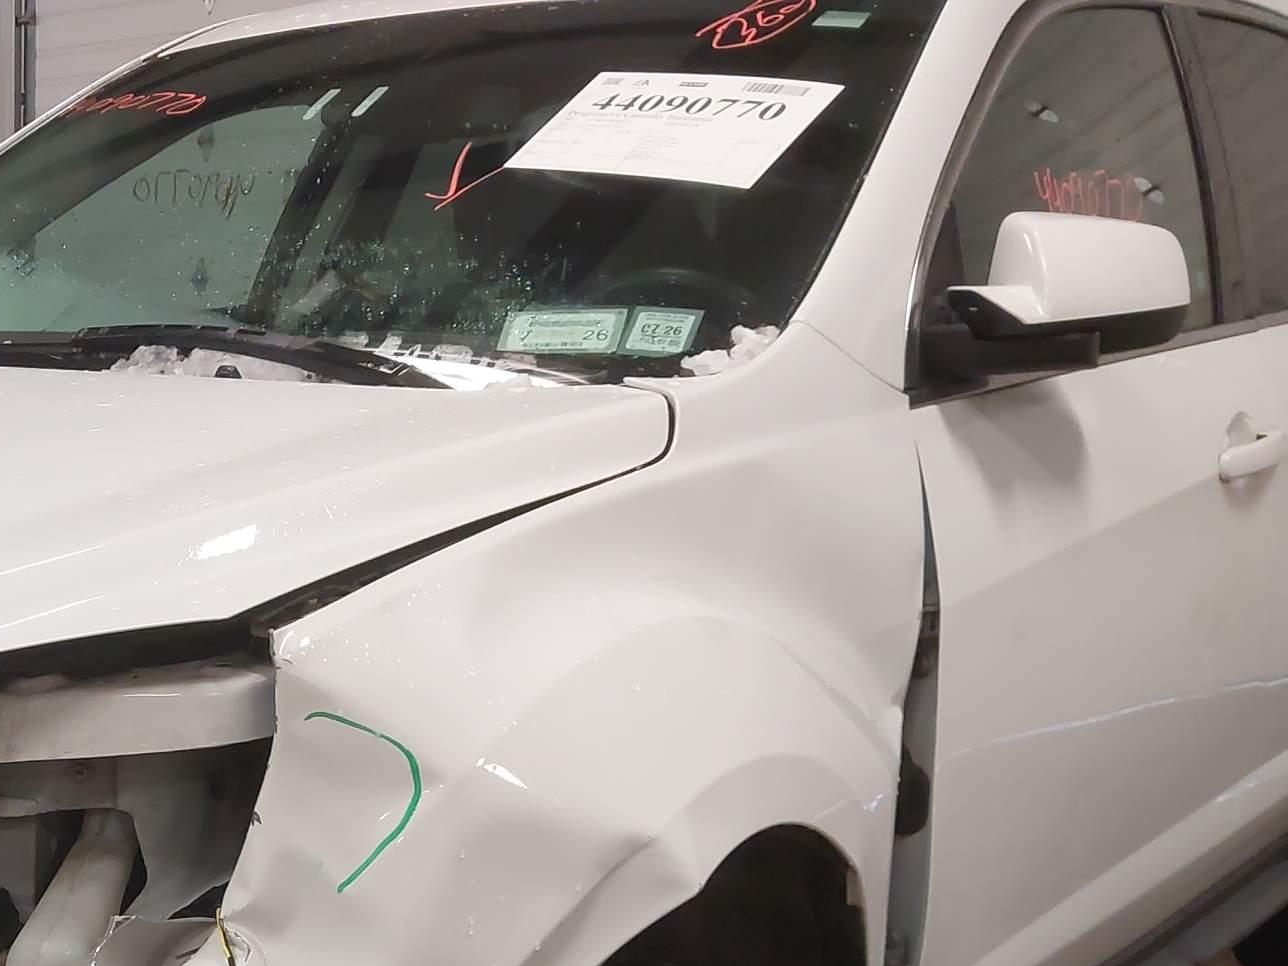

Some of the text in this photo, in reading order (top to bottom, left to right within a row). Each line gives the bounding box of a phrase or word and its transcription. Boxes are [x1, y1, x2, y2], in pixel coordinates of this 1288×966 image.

[591, 92, 787, 121] 44090770
[582, 328, 609, 342] 26
[663, 325, 683, 336] 26
